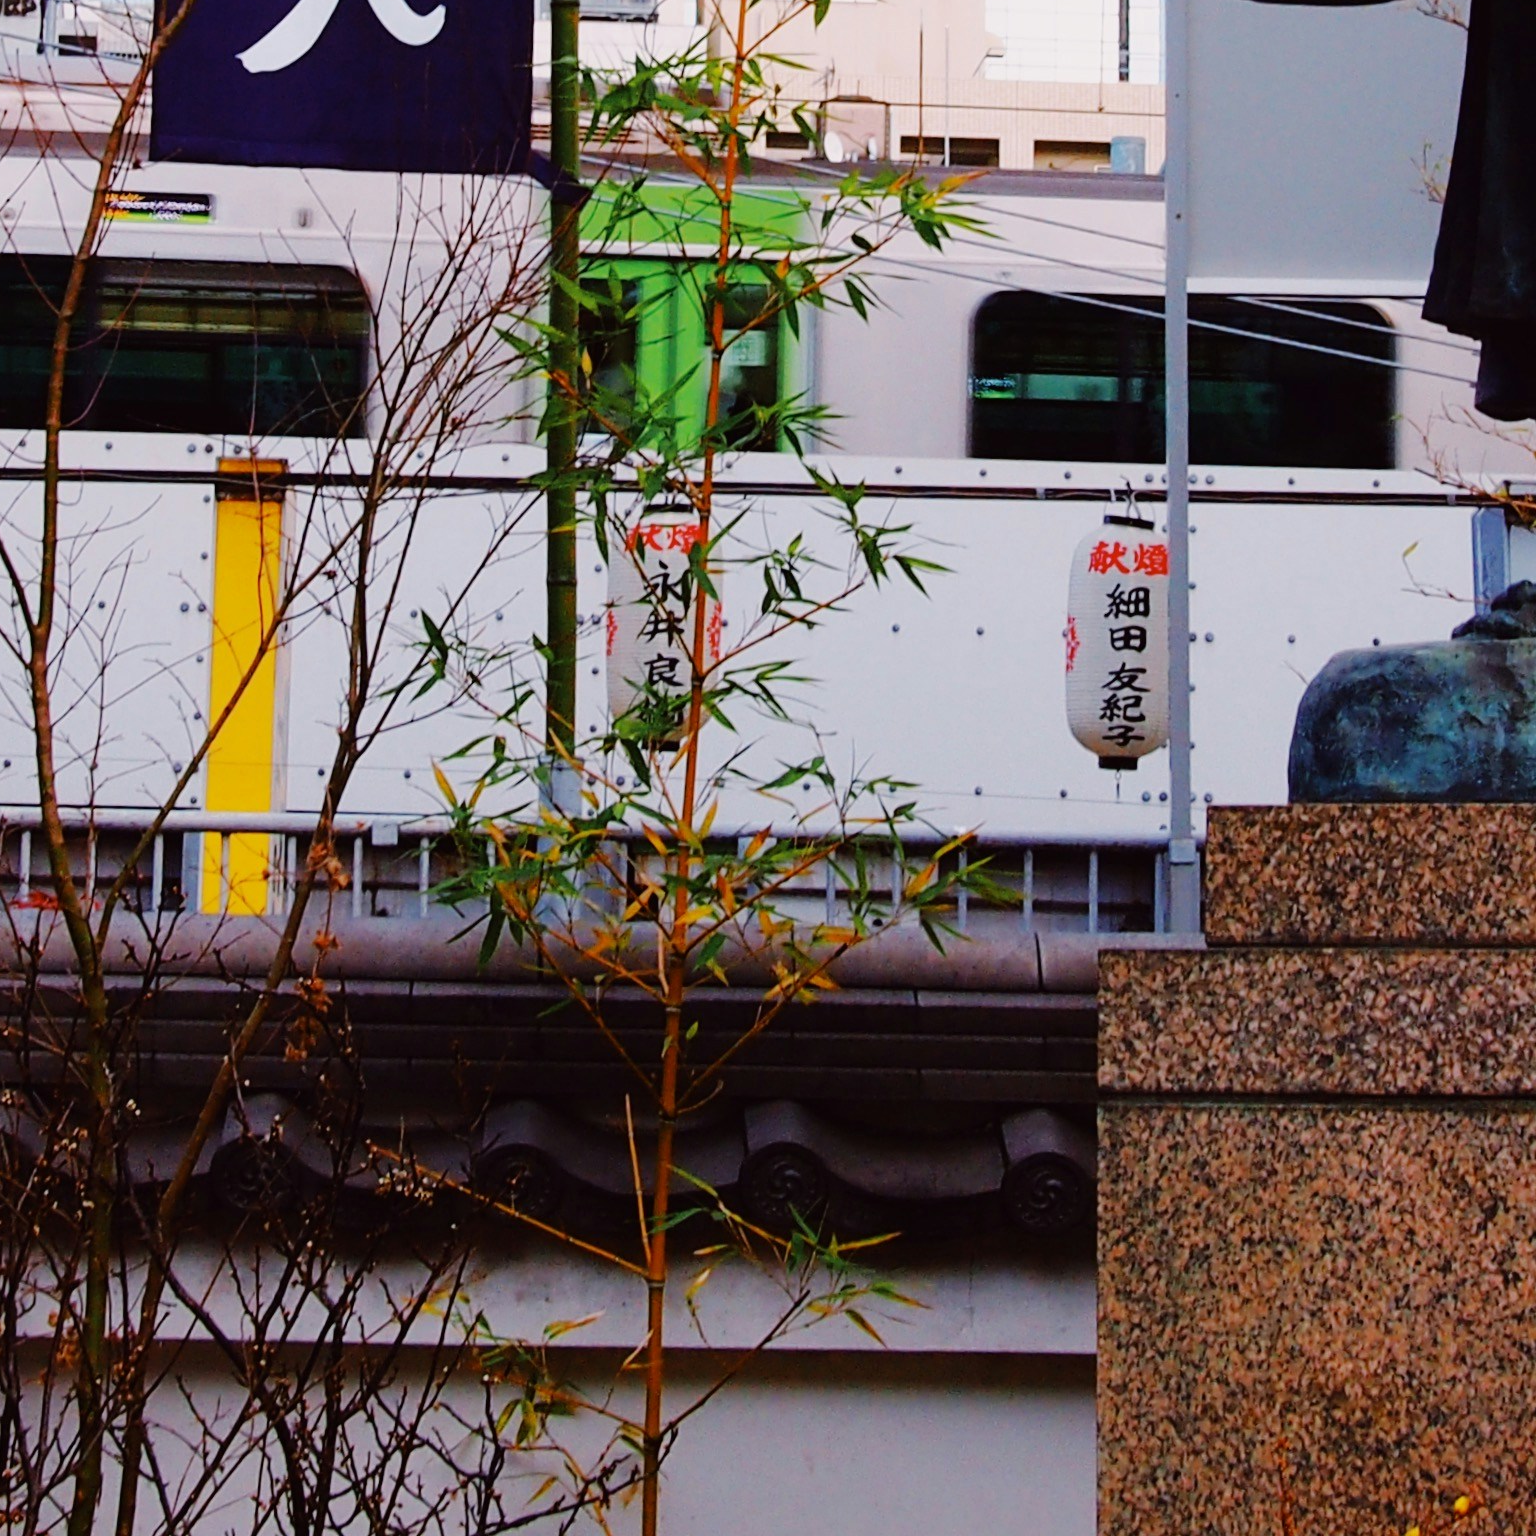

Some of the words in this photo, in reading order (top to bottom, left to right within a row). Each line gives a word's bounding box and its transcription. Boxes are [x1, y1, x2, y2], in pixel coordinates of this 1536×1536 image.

[1099, 583, 1152, 748] 細田友紀子
